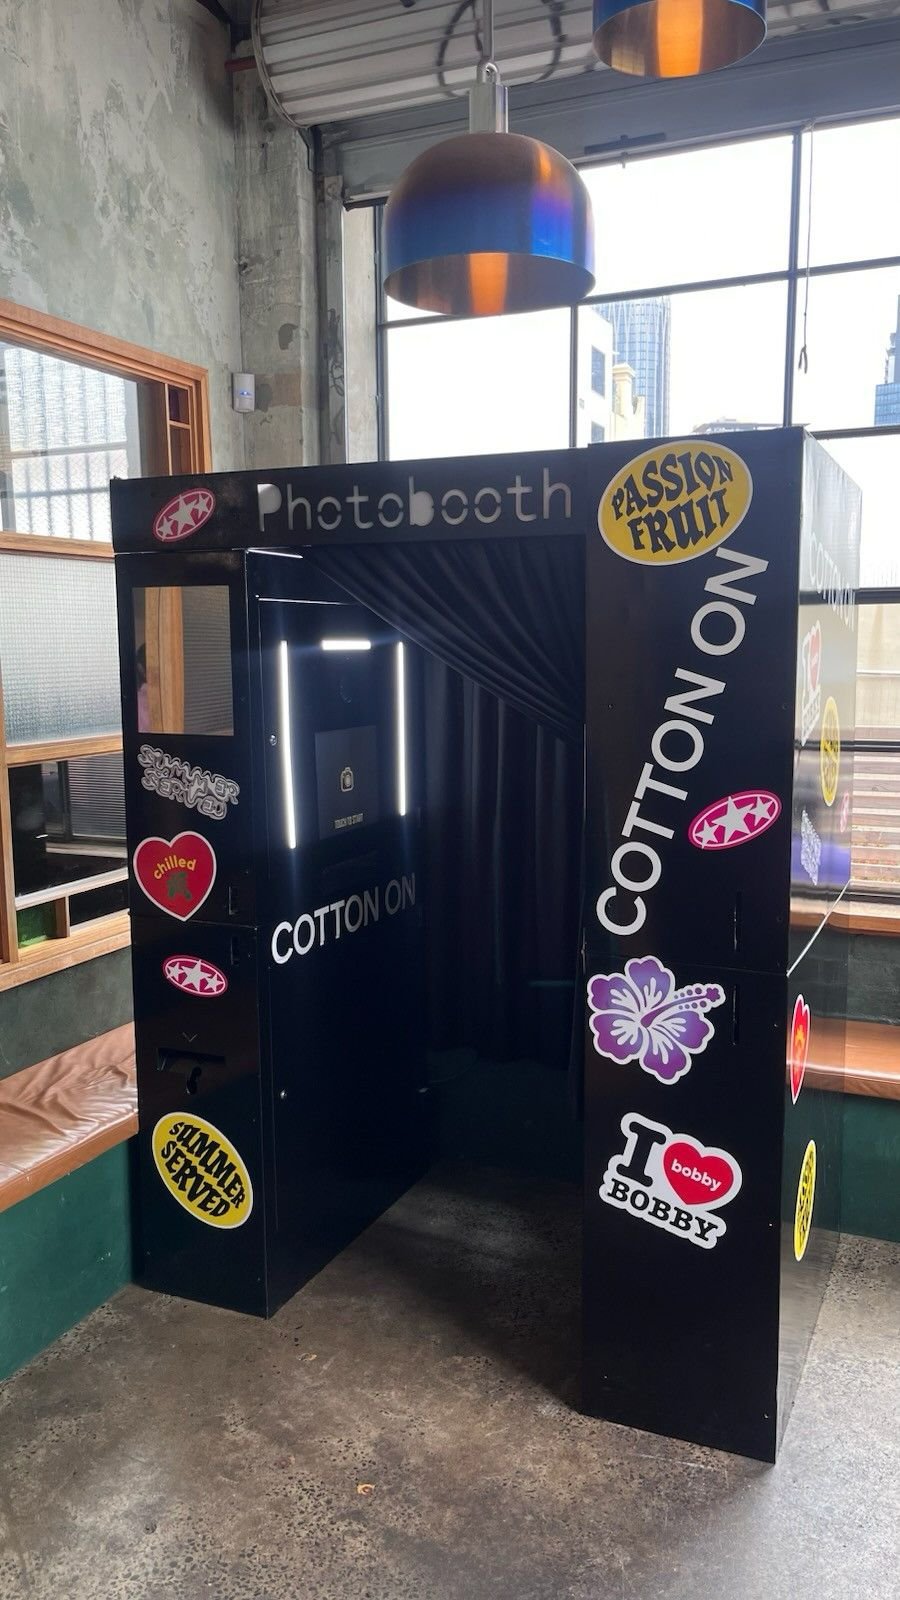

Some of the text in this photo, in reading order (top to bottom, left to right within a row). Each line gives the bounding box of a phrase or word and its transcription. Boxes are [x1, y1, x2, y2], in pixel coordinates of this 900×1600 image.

[257, 468, 572, 532] Photobooth
[611, 452, 734, 521] PASSION
[627, 489, 730, 554] FRUIT
[596, 547, 769, 936] COTTON ON
[154, 855, 196, 879] chilled
[271, 873, 416, 965] COTTON ON
[161, 1140, 230, 1217] SERVED
[169, 1122, 245, 1209] SUMMER
[616, 1121, 722, 1191] I bobby
[607, 1178, 718, 1241] BOBBY
